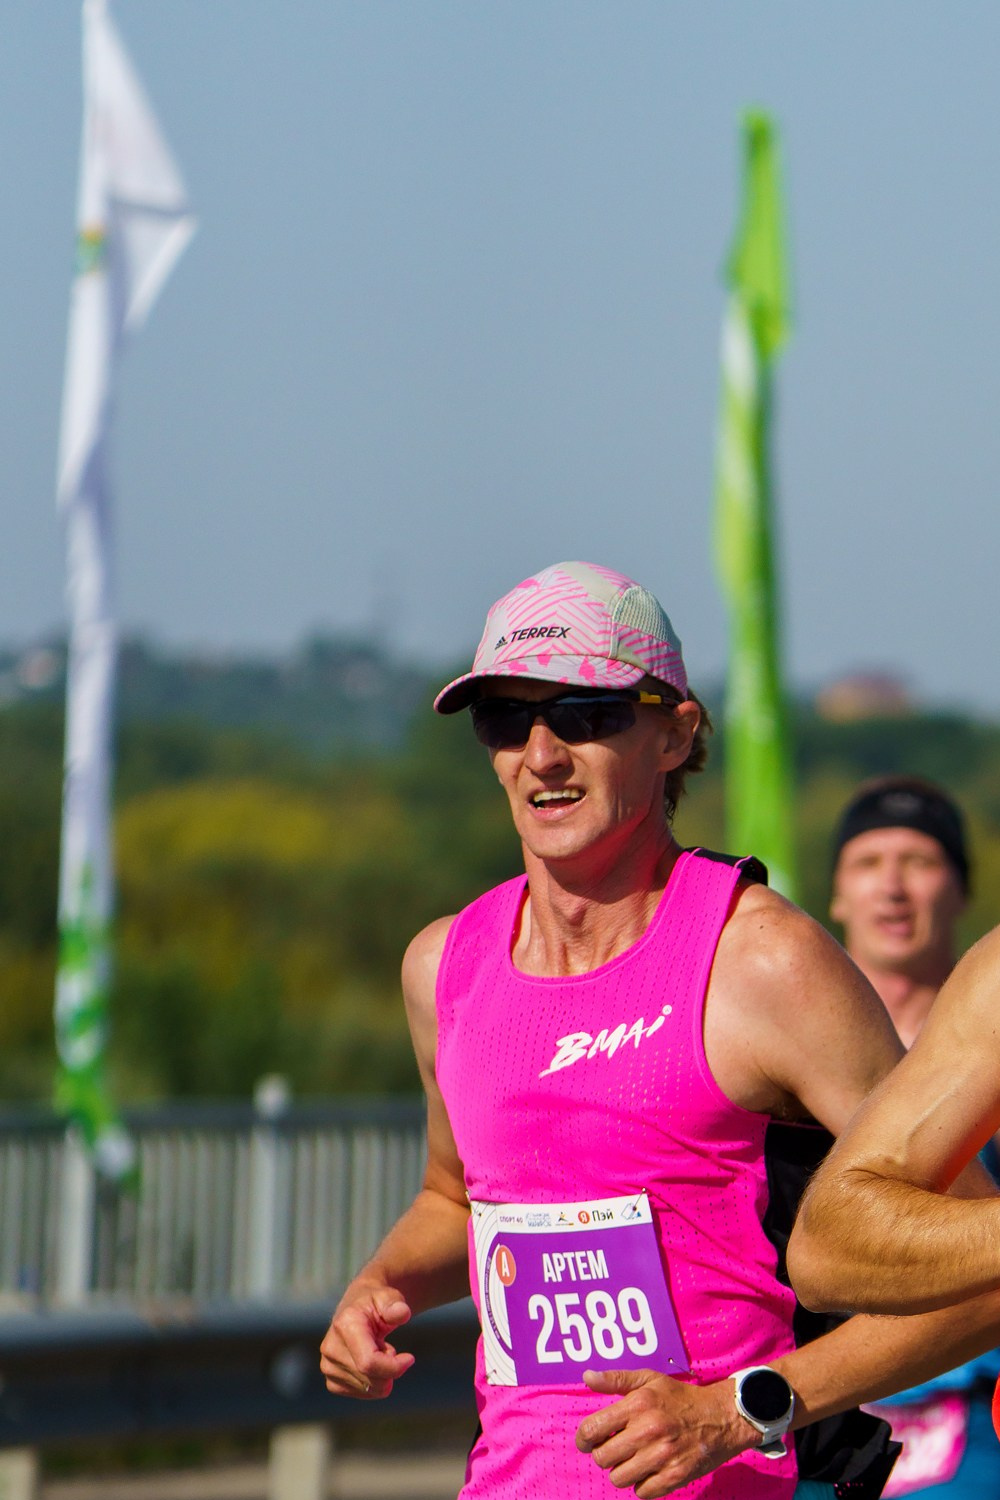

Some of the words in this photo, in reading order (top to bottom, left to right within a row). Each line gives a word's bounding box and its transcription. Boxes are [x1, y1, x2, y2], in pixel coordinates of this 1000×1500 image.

[511, 627, 571, 642] TERREX
[592, 1208, 614, 1222] Пэй
[542, 1249, 609, 1283] АРТЕМ
[527, 1286, 658, 1364] 2589
